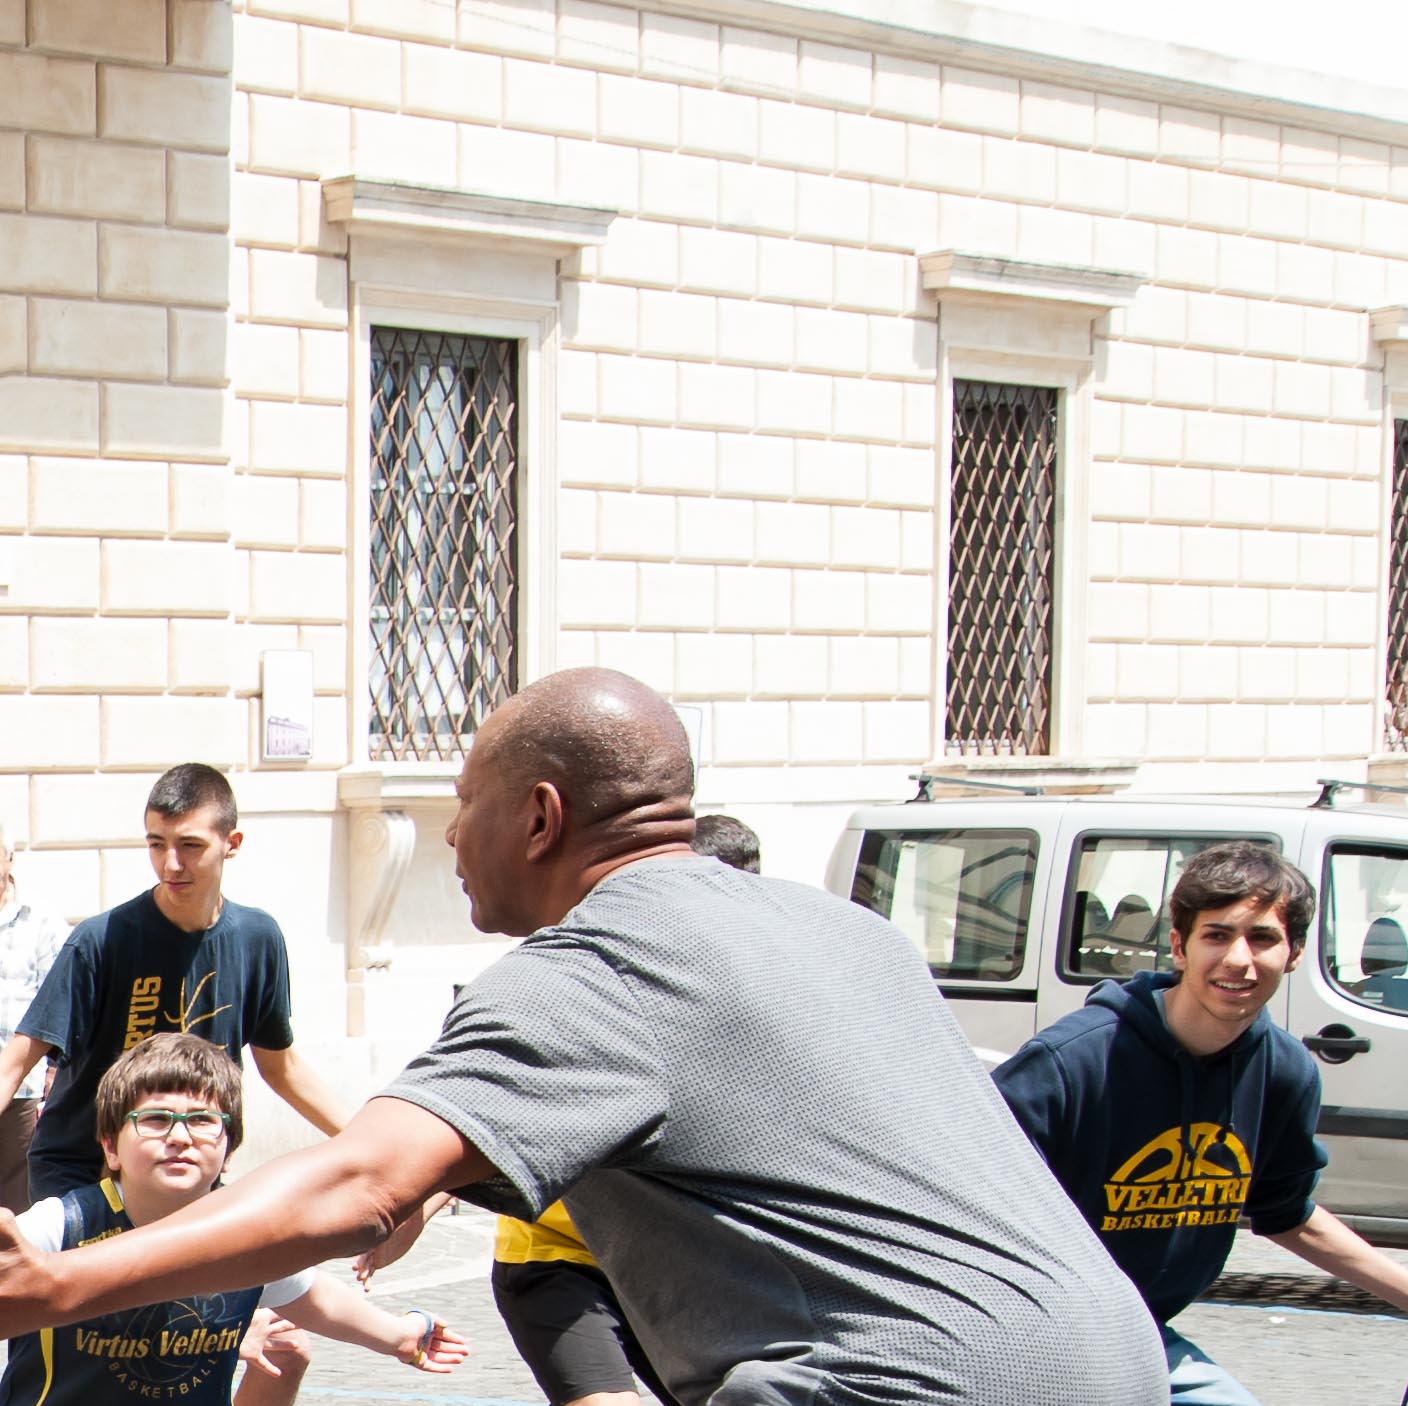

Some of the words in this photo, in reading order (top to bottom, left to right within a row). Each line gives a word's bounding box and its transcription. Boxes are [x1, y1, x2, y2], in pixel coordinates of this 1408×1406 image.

[123, 976, 161, 1053] RTUS
[1104, 1177, 1251, 1212] VELLETRI
[1101, 1209, 1241, 1231] BASKETBALL
[76, 1328, 151, 1358] Virtus
[160, 1321, 243, 1358] Velletri
[108, 1357, 218, 1399] BASKETBALL
